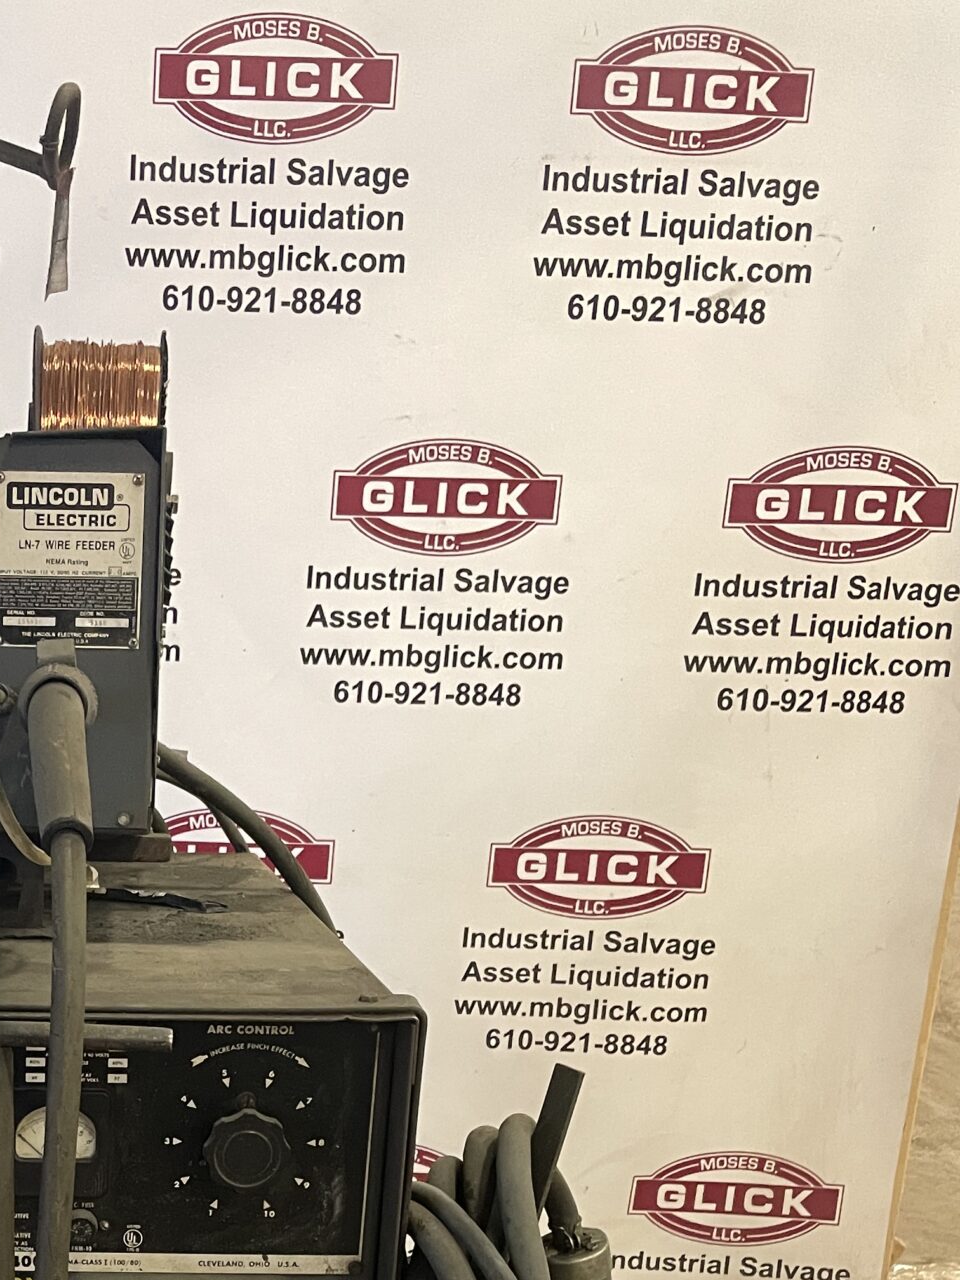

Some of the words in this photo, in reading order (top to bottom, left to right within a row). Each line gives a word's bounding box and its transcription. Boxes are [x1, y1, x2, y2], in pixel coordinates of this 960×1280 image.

[655, 33, 721, 52] MOSES
[727, 37, 742, 55] B.
[605, 71, 779, 111] GLICK
[669, 131, 705, 148] LLC.
[543, 165, 688, 195] Industrial
[699, 169, 819, 206] Salvage
[541, 208, 631, 236] Asset
[641, 211, 812, 245] Liquidation
[534, 254, 811, 287] www.mbglick.com
[568, 294, 765, 324] 610-921-8848
[409, 446, 472, 463] MOSES
[477, 448, 492, 464] B.
[12, 487, 108, 506] LINCOLN
[363, 481, 529, 515] GLICK
[36, 513, 116, 526] ELECTRIC
[19, 540, 40, 549] LN-7
[46, 540, 70, 549] WIRE
[76, 540, 115, 550] FEEDER
[424, 535, 459, 550] LLC.
[307, 565, 444, 591] Industrial
[454, 568, 569, 600] Salvage
[306, 604, 390, 629] Asset
[401, 606, 562, 636] Liquidation
[300, 644, 563, 673] www.mbglick.com
[334, 680, 521, 706] 610-921-8848
[562, 821, 622, 836] MOSES
[627, 824, 641, 839] B.
[517, 853, 678, 884] GLICK
[575, 900, 608, 914] LLC.
[463, 927, 593, 951] Industrial
[604, 931, 715, 960] Salvage
[461, 961, 541, 983] Asset
[551, 964, 708, 991] Liquidation
[455, 997, 707, 1024] www.mbglick.com
[207, 1025, 232, 1034] ARC
[237, 1025, 294, 1034] CONTROL
[486, 1029, 667, 1055] 610-921-8848
[210, 1043, 244, 1057] INCREASE
[271, 1046, 295, 1058] EFFECT
[264, 1210, 275, 1218] 10
[249, 1260, 270, 1268] OHIO
